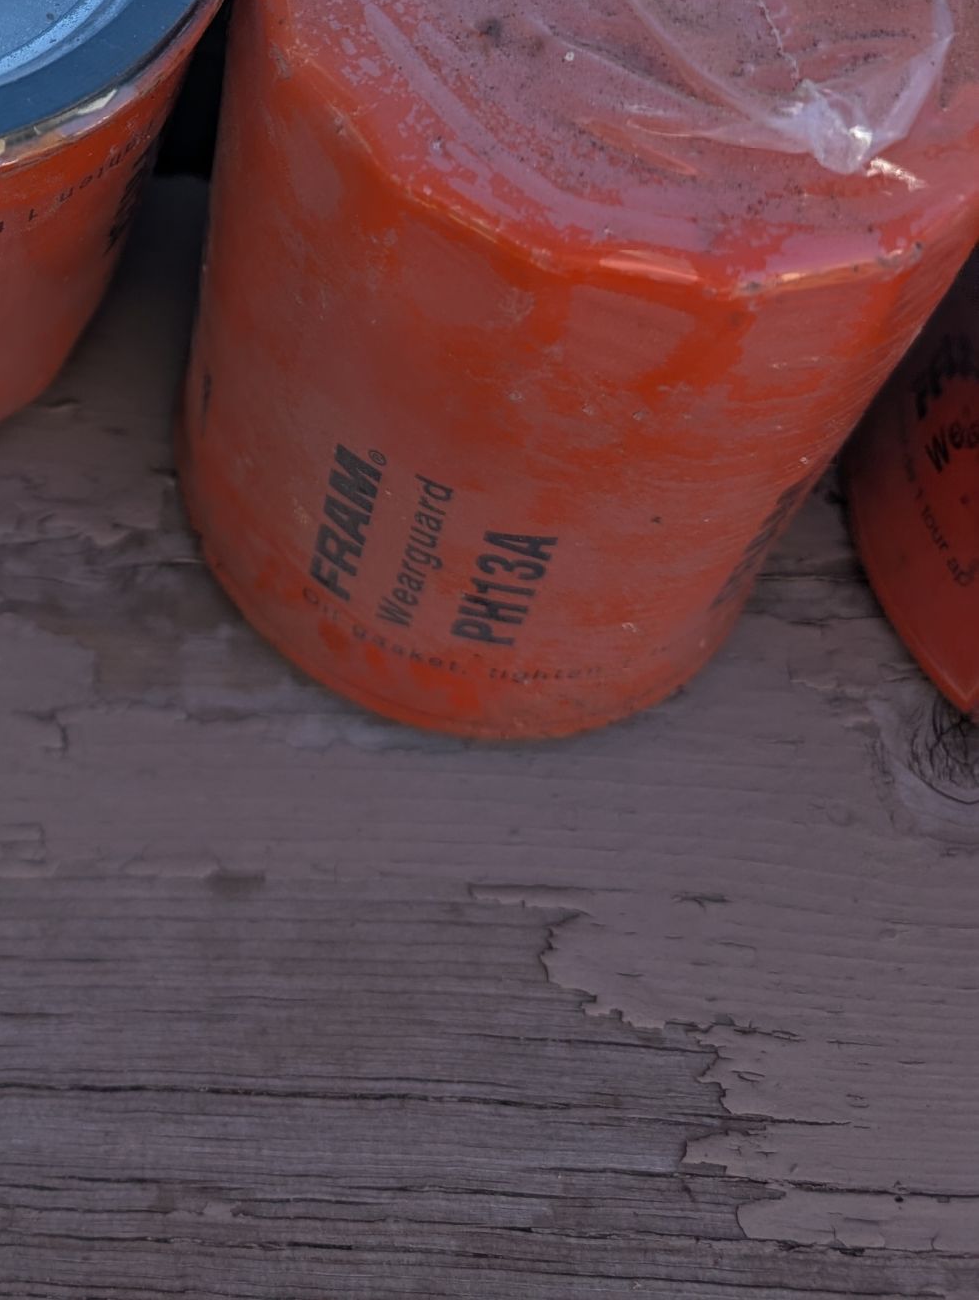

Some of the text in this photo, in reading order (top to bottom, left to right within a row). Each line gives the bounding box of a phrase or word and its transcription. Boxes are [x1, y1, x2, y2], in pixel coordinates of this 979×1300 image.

[27, 207, 39, 222] 1
[375, 474, 454, 629] Wearguard
[450, 531, 558, 647] PH13A
